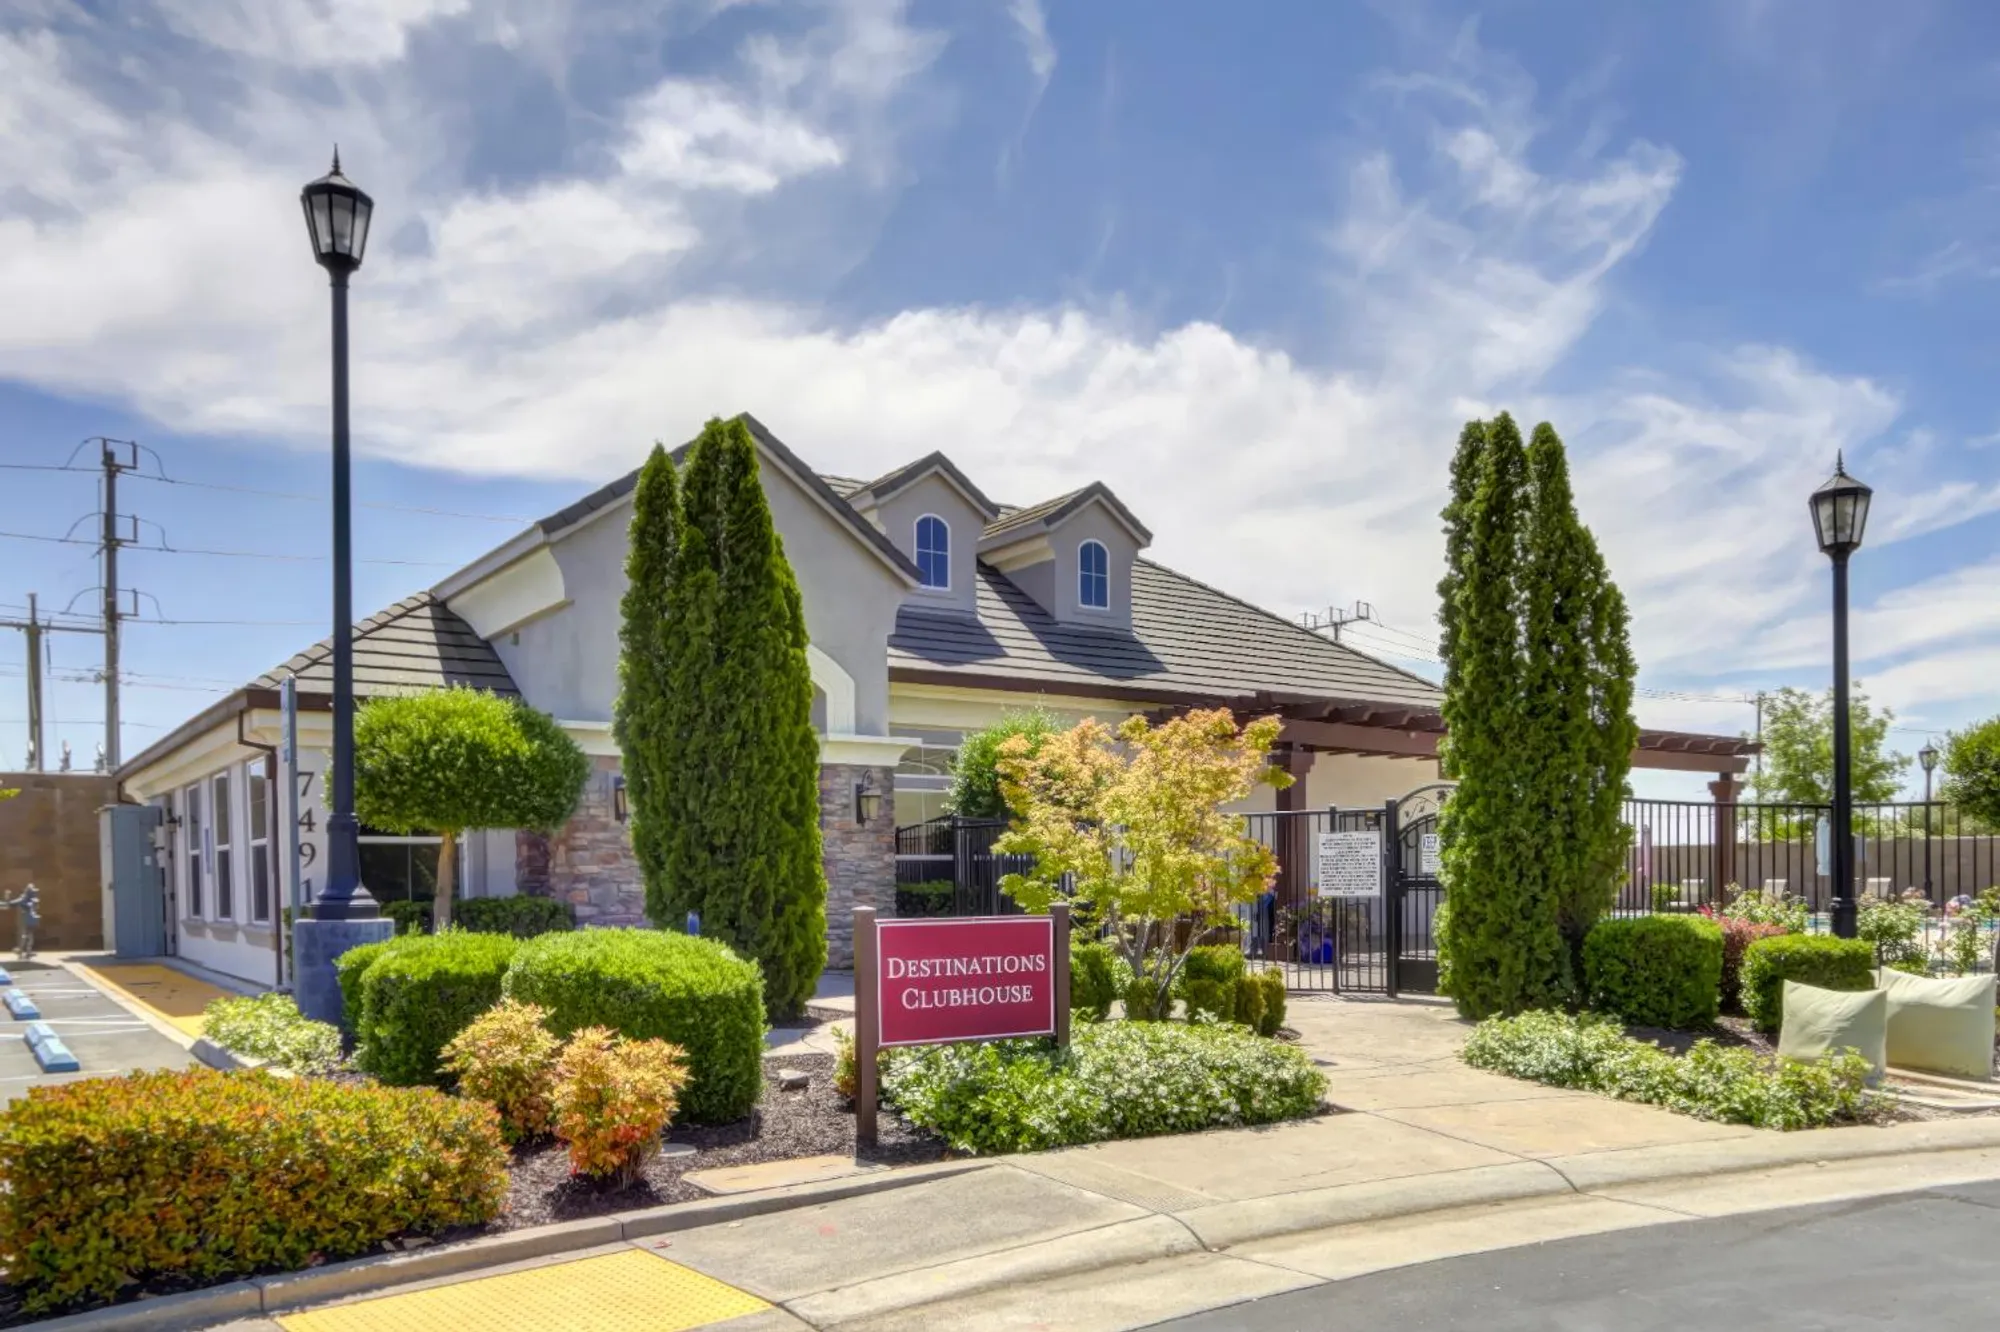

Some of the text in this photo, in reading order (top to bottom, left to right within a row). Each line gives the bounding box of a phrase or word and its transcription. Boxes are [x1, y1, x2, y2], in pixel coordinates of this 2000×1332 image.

[297, 771, 317, 904] 7491
[887, 954, 1046, 979] DESTINATIONS
[901, 984, 1034, 1009] CLUBHOUSE
